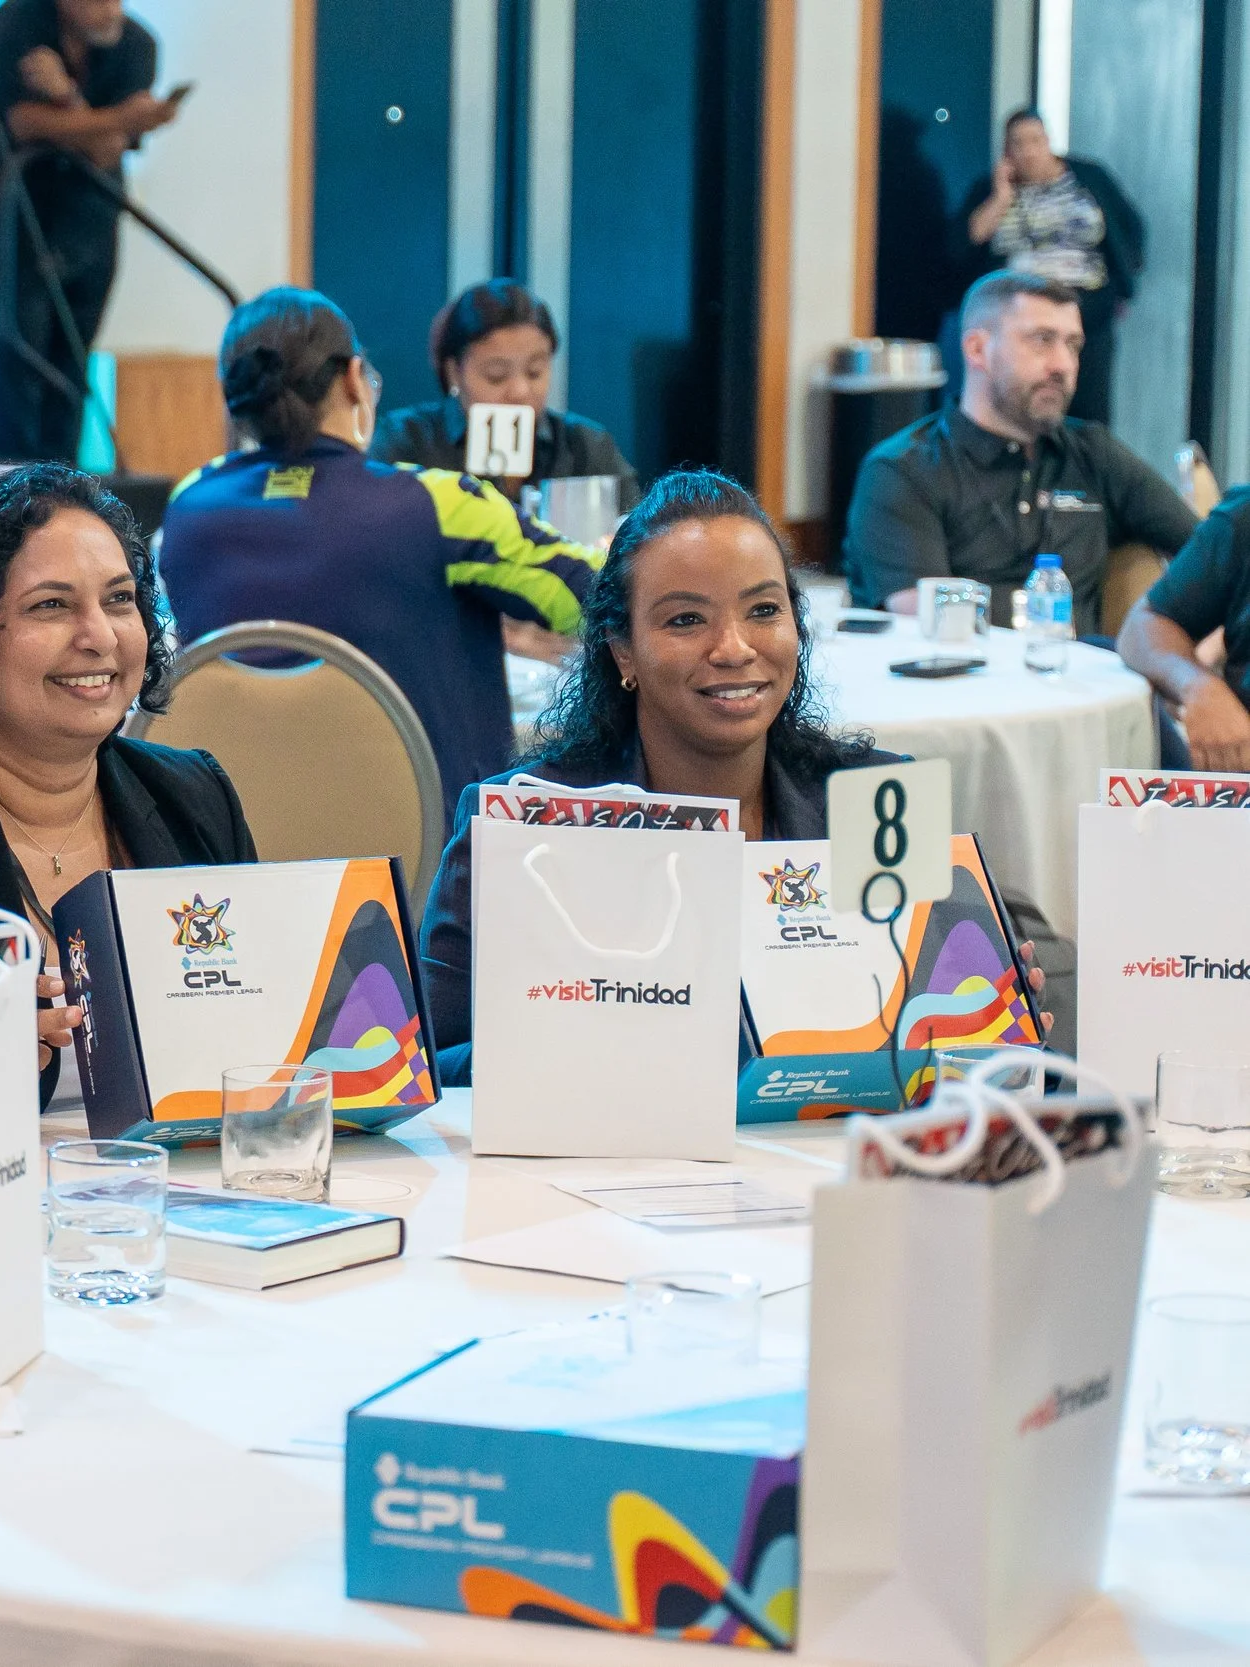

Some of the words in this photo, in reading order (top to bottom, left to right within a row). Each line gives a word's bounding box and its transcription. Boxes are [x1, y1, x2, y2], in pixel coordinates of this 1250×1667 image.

[485, 413, 521, 455] 11
[874, 778, 908, 867] 8
[780, 925, 838, 941] CPL
[194, 958, 220, 968] Republic
[222, 957, 237, 965] Bank
[183, 970, 242, 988] CPL
[527, 978, 691, 1005] #visitTrinidad
[80, 995, 93, 1053] CPL
[785, 1071, 825, 1079] Republic
[757, 1080, 840, 1097] CPL
[750, 1096, 805, 1104] CARIBBEAN
[807, 1093, 850, 1101] PREMIER
[372, 1488, 505, 1539] CPL
